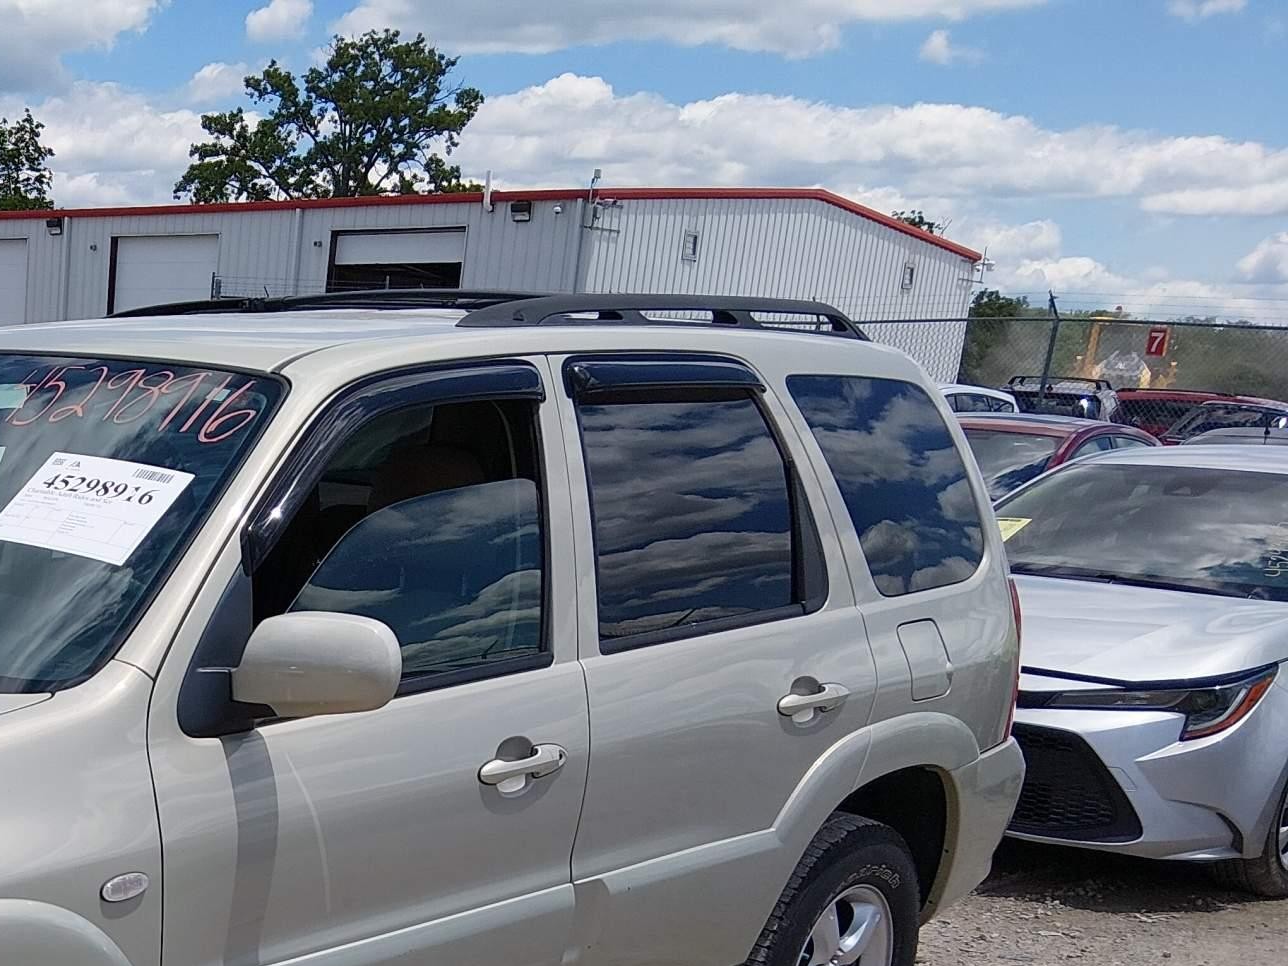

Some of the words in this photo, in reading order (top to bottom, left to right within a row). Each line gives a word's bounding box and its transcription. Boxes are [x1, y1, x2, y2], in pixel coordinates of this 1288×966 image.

[1150, 332, 1165, 353] 7
[6, 366, 258, 443] 45298916
[42, 473, 162, 507] 45298916
